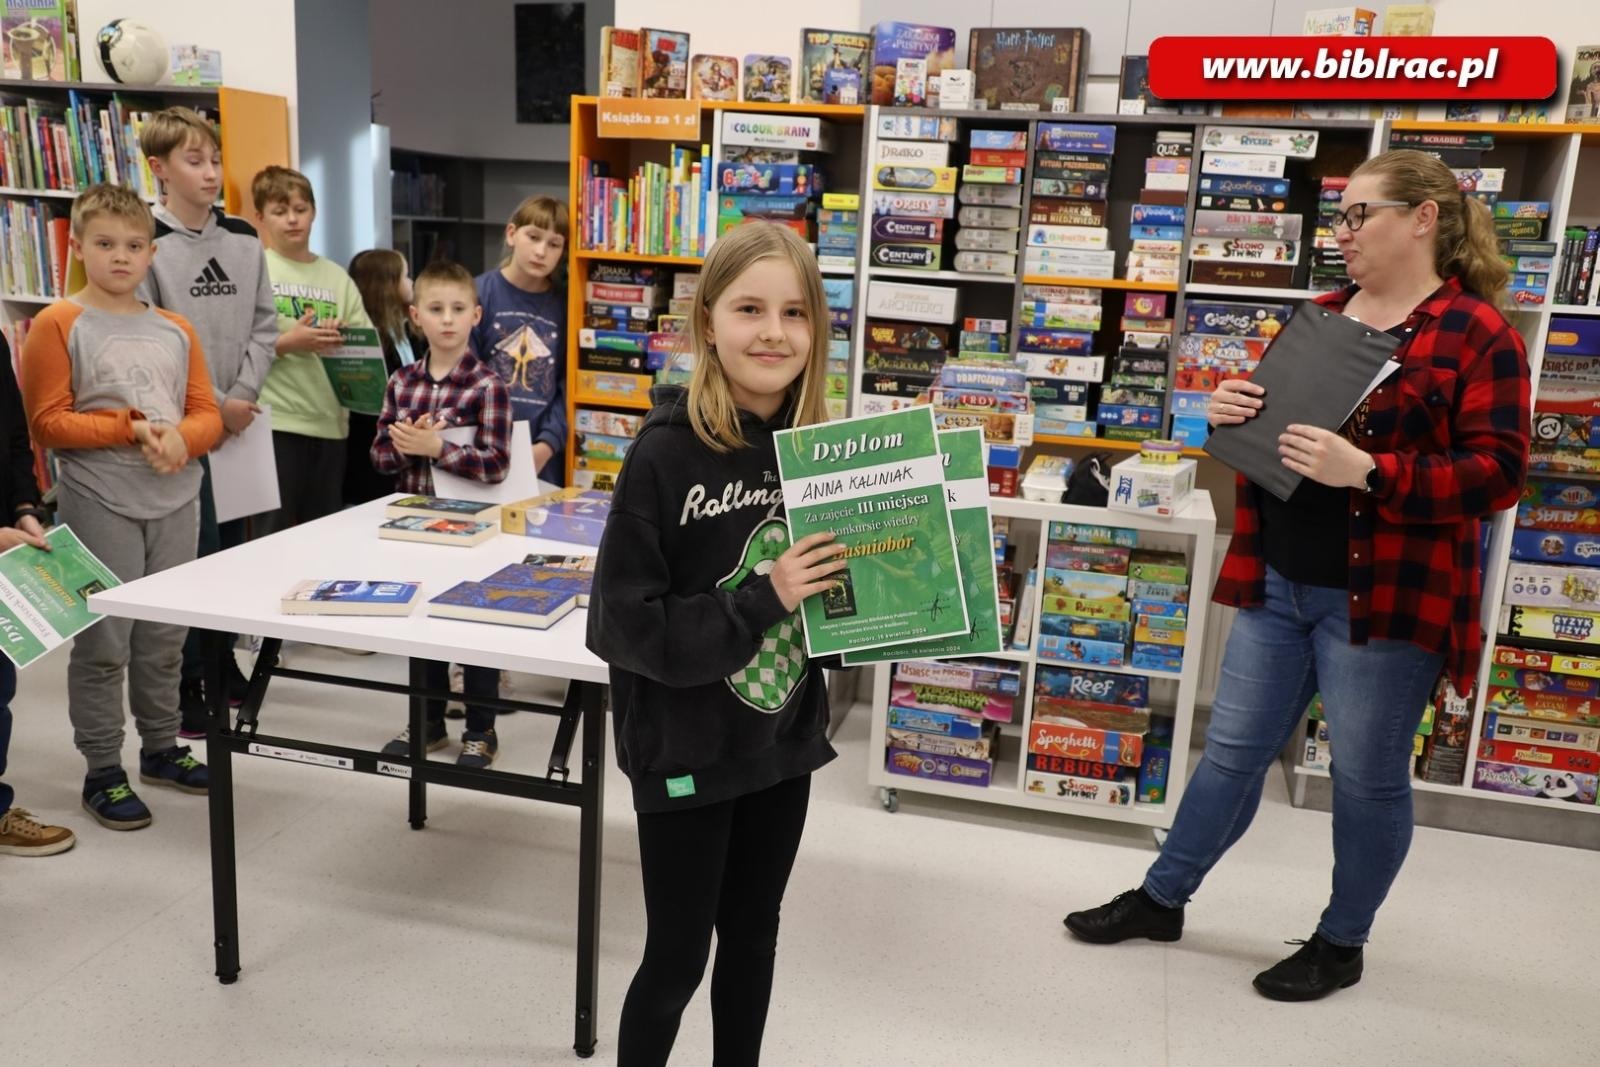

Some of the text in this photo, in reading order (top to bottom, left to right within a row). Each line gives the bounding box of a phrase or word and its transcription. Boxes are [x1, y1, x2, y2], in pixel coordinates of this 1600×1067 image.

[807, 32, 829, 46] TOP
[602, 112, 697, 127] Książka za 1 zł
[775, 123, 811, 138] BRAIN
[1156, 143, 1179, 156] QUIZ
[1058, 206, 1079, 216] PARK
[886, 220, 926, 234] CENTURY
[878, 247, 926, 262] CENTURY
[272, 283, 337, 302] SURVIVAL
[1576, 362, 1589, 371] DO
[874, 381, 898, 392] TIME
[1540, 422, 1558, 436] CV
[812, 432, 904, 462] Dyplom
[762, 470, 778, 482] The
[801, 466, 914, 503] ANNA KALINIAK
[805, 493, 930, 524] Za zajęcie III miejsca
[884, 514, 920, 530] wiedzy
[1554, 615, 1593, 627] RYZYK
[1554, 625, 1589, 636] FIZYK
[1070, 675, 1115, 697] Reef
[1036, 729, 1099, 751] Spaghetti
[1035, 754, 1119, 780] REBUSY
